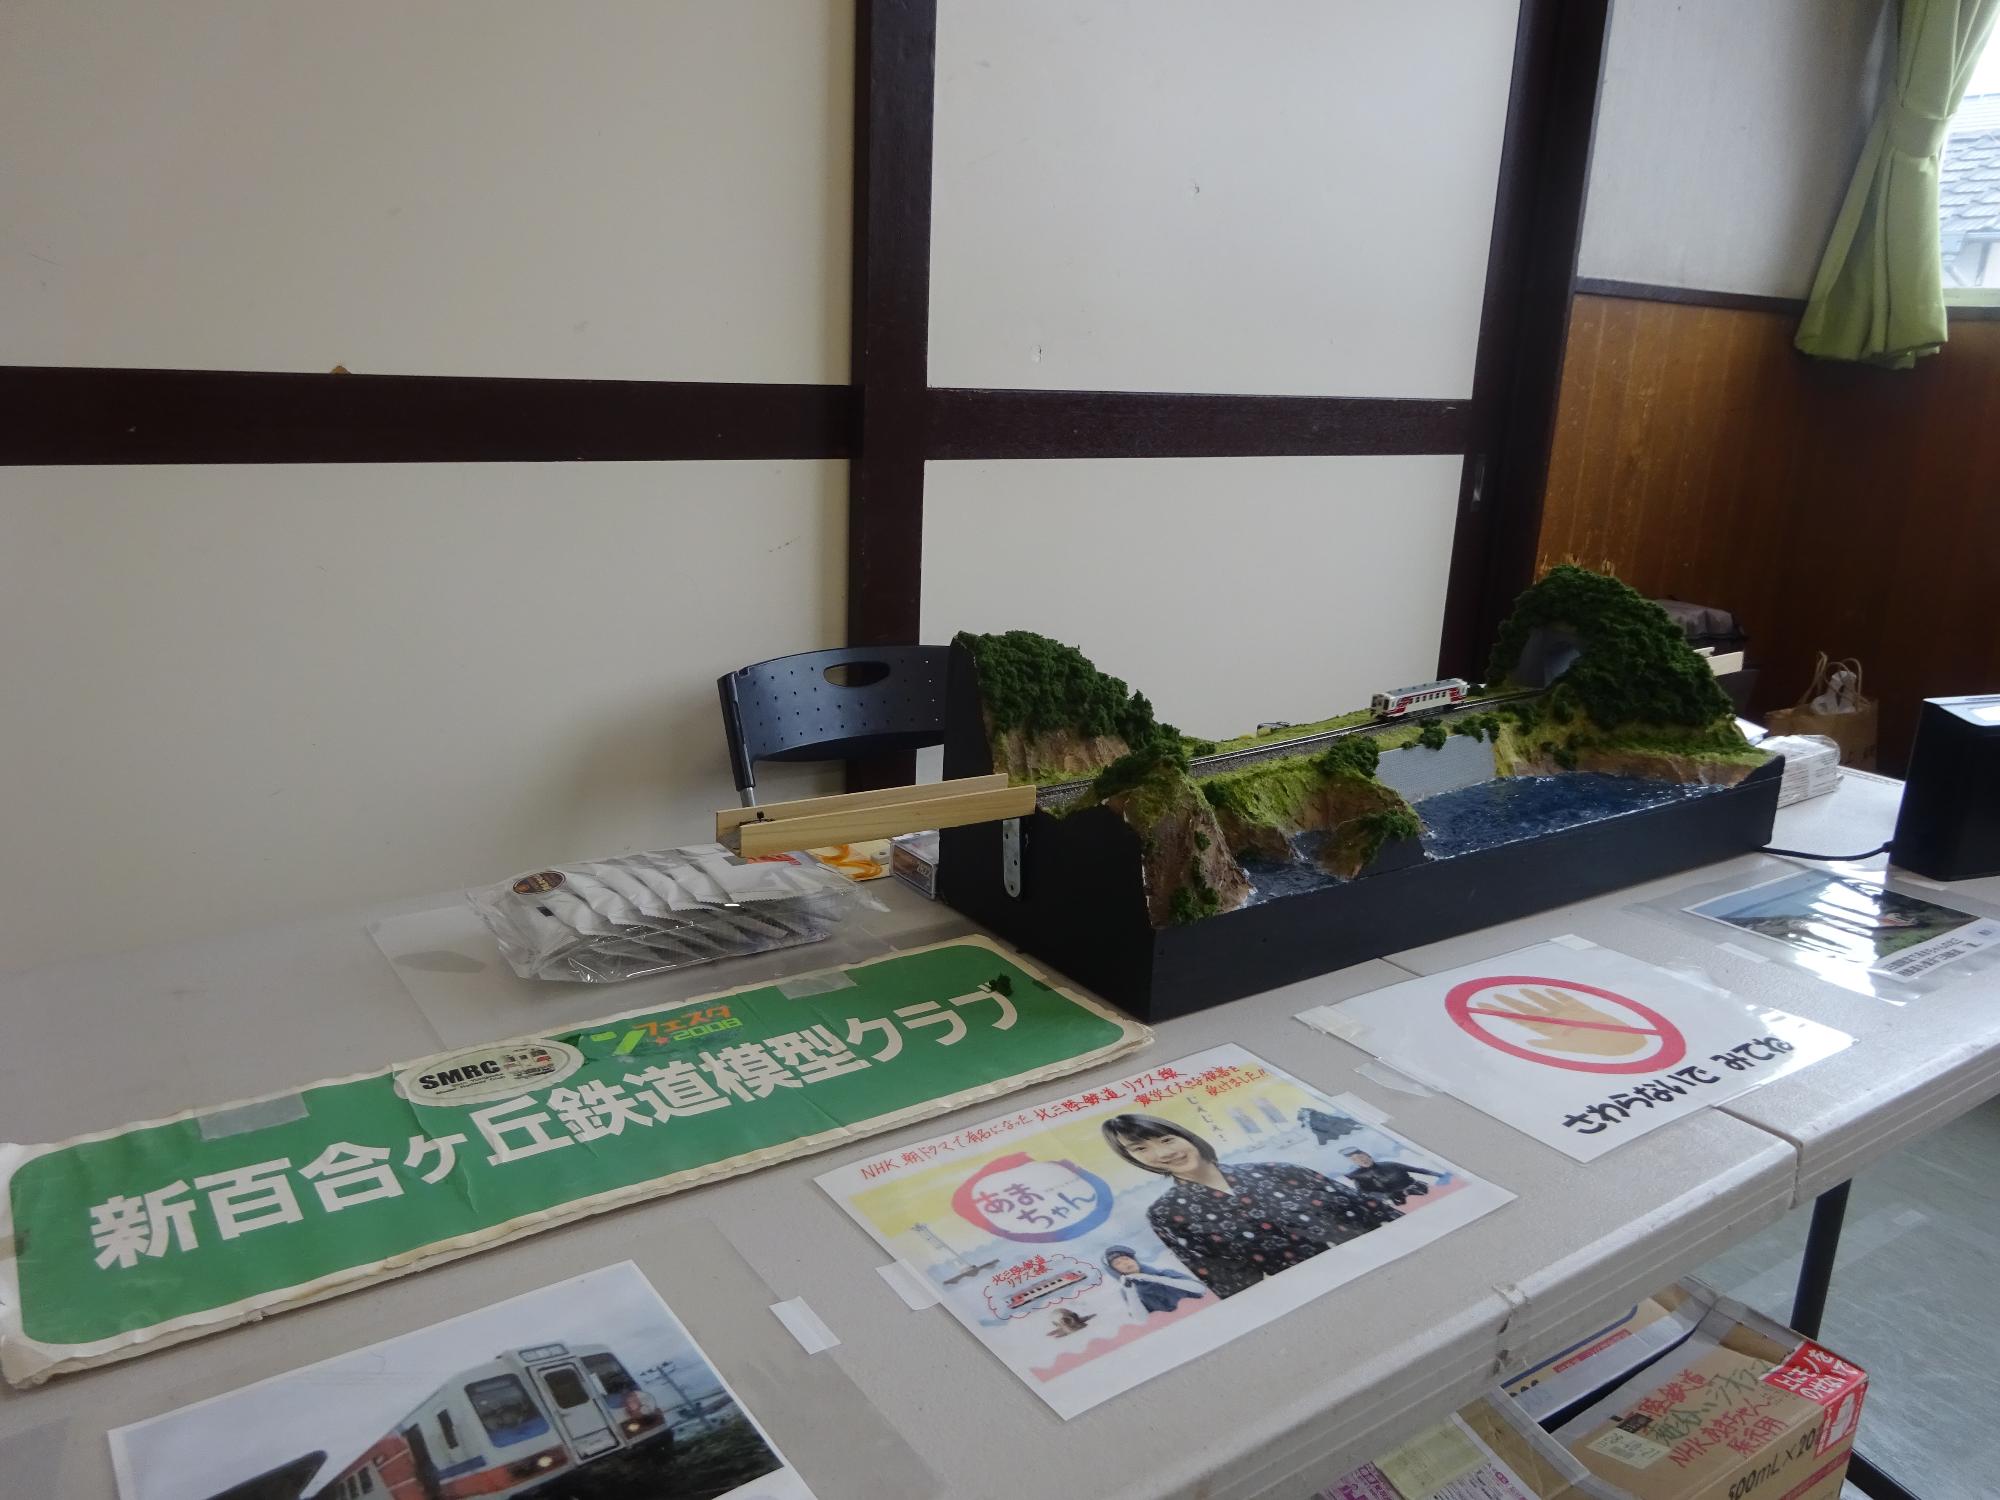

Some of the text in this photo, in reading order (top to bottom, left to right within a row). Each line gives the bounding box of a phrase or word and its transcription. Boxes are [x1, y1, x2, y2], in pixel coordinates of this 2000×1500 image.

[673, 1018, 743, 1040] 2008
[419, 1060, 501, 1089] SMRC
[1562, 1036, 1794, 1134] さわらないで みてね
[860, 1159, 900, 1180] NHK
[1669, 1434, 1711, 1469] NHK
